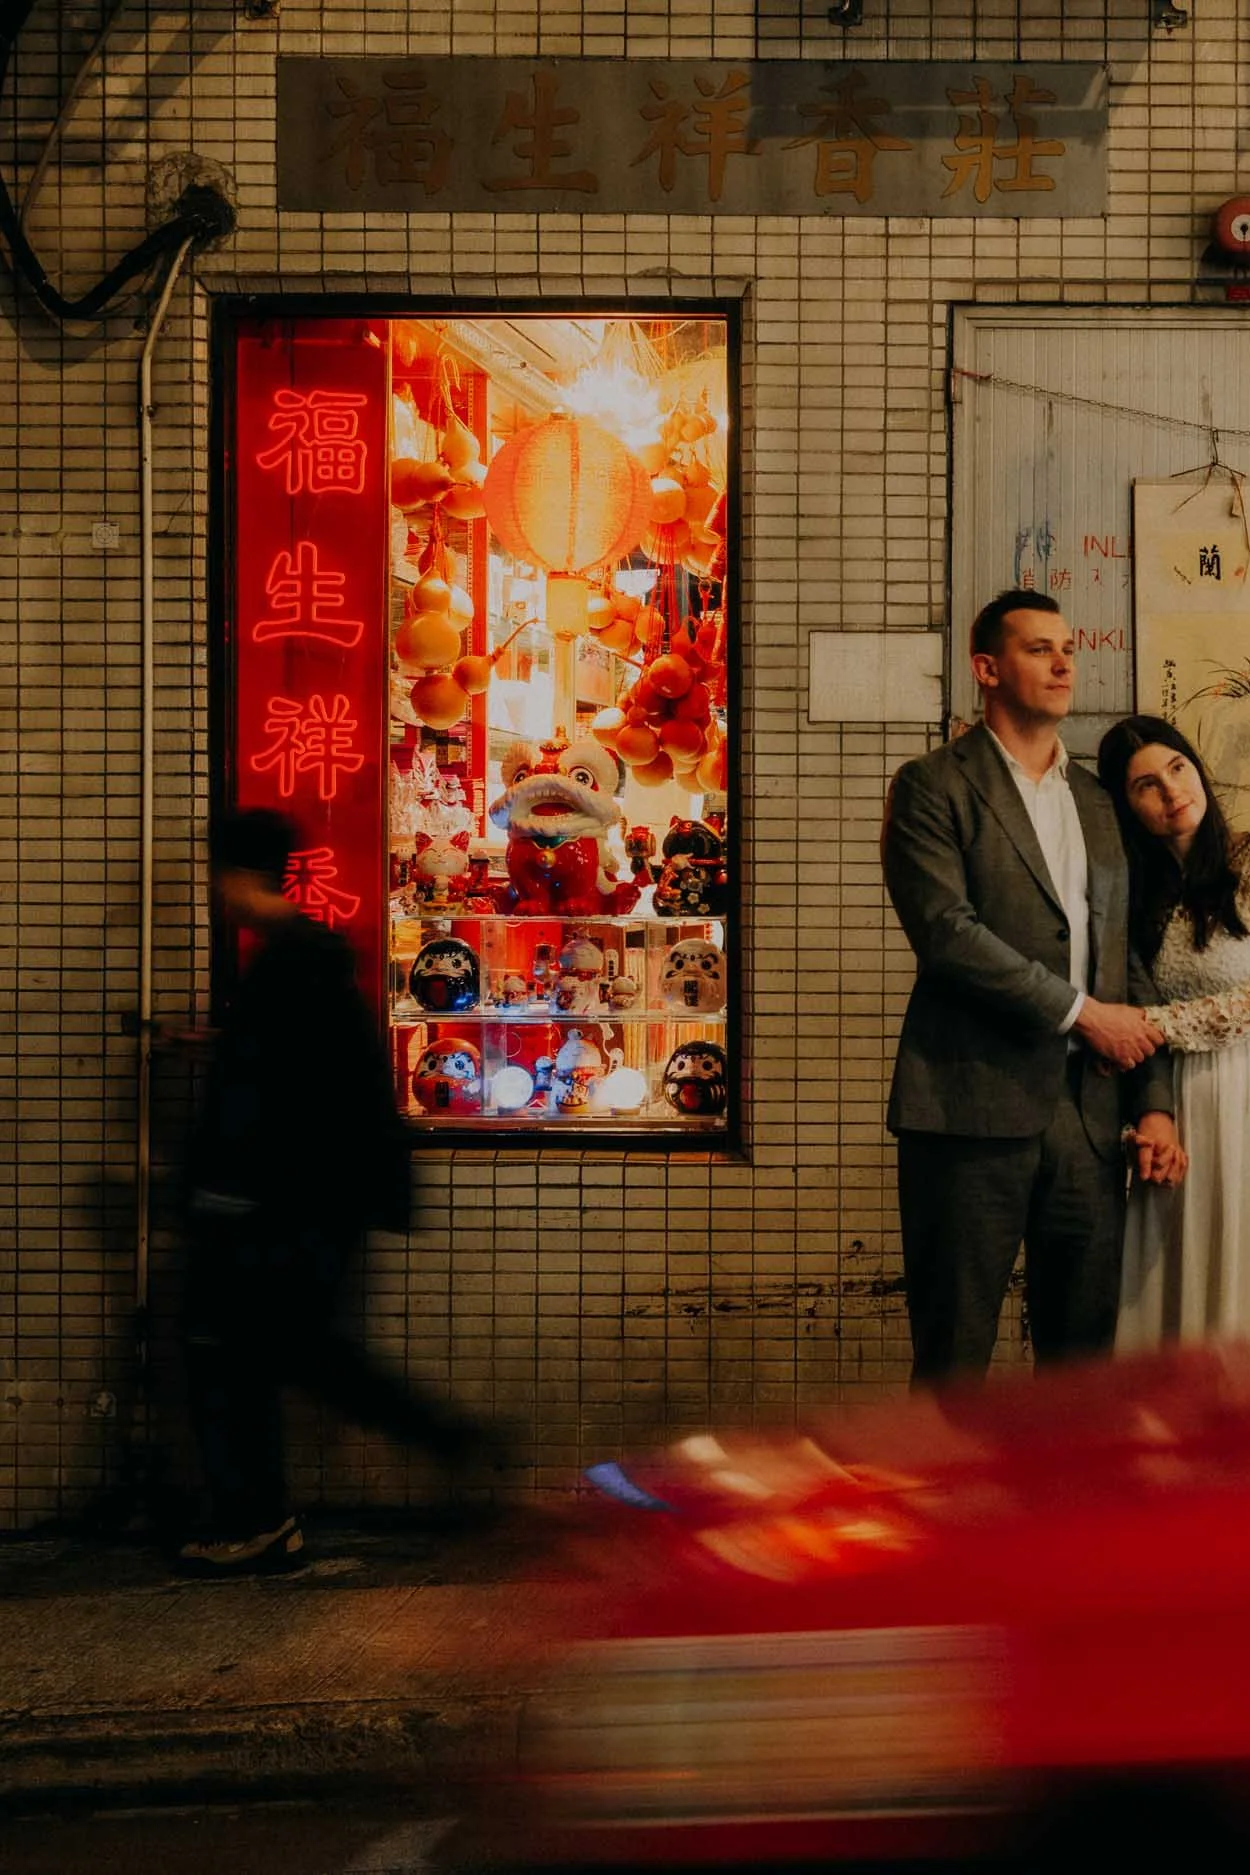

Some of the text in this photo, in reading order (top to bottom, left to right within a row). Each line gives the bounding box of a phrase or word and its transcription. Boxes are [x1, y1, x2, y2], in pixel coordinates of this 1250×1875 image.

[315, 68, 1067, 203] 福生祥香莊
[1083, 535, 1132, 558] INL
[1199, 543, 1221, 581] 蘭
